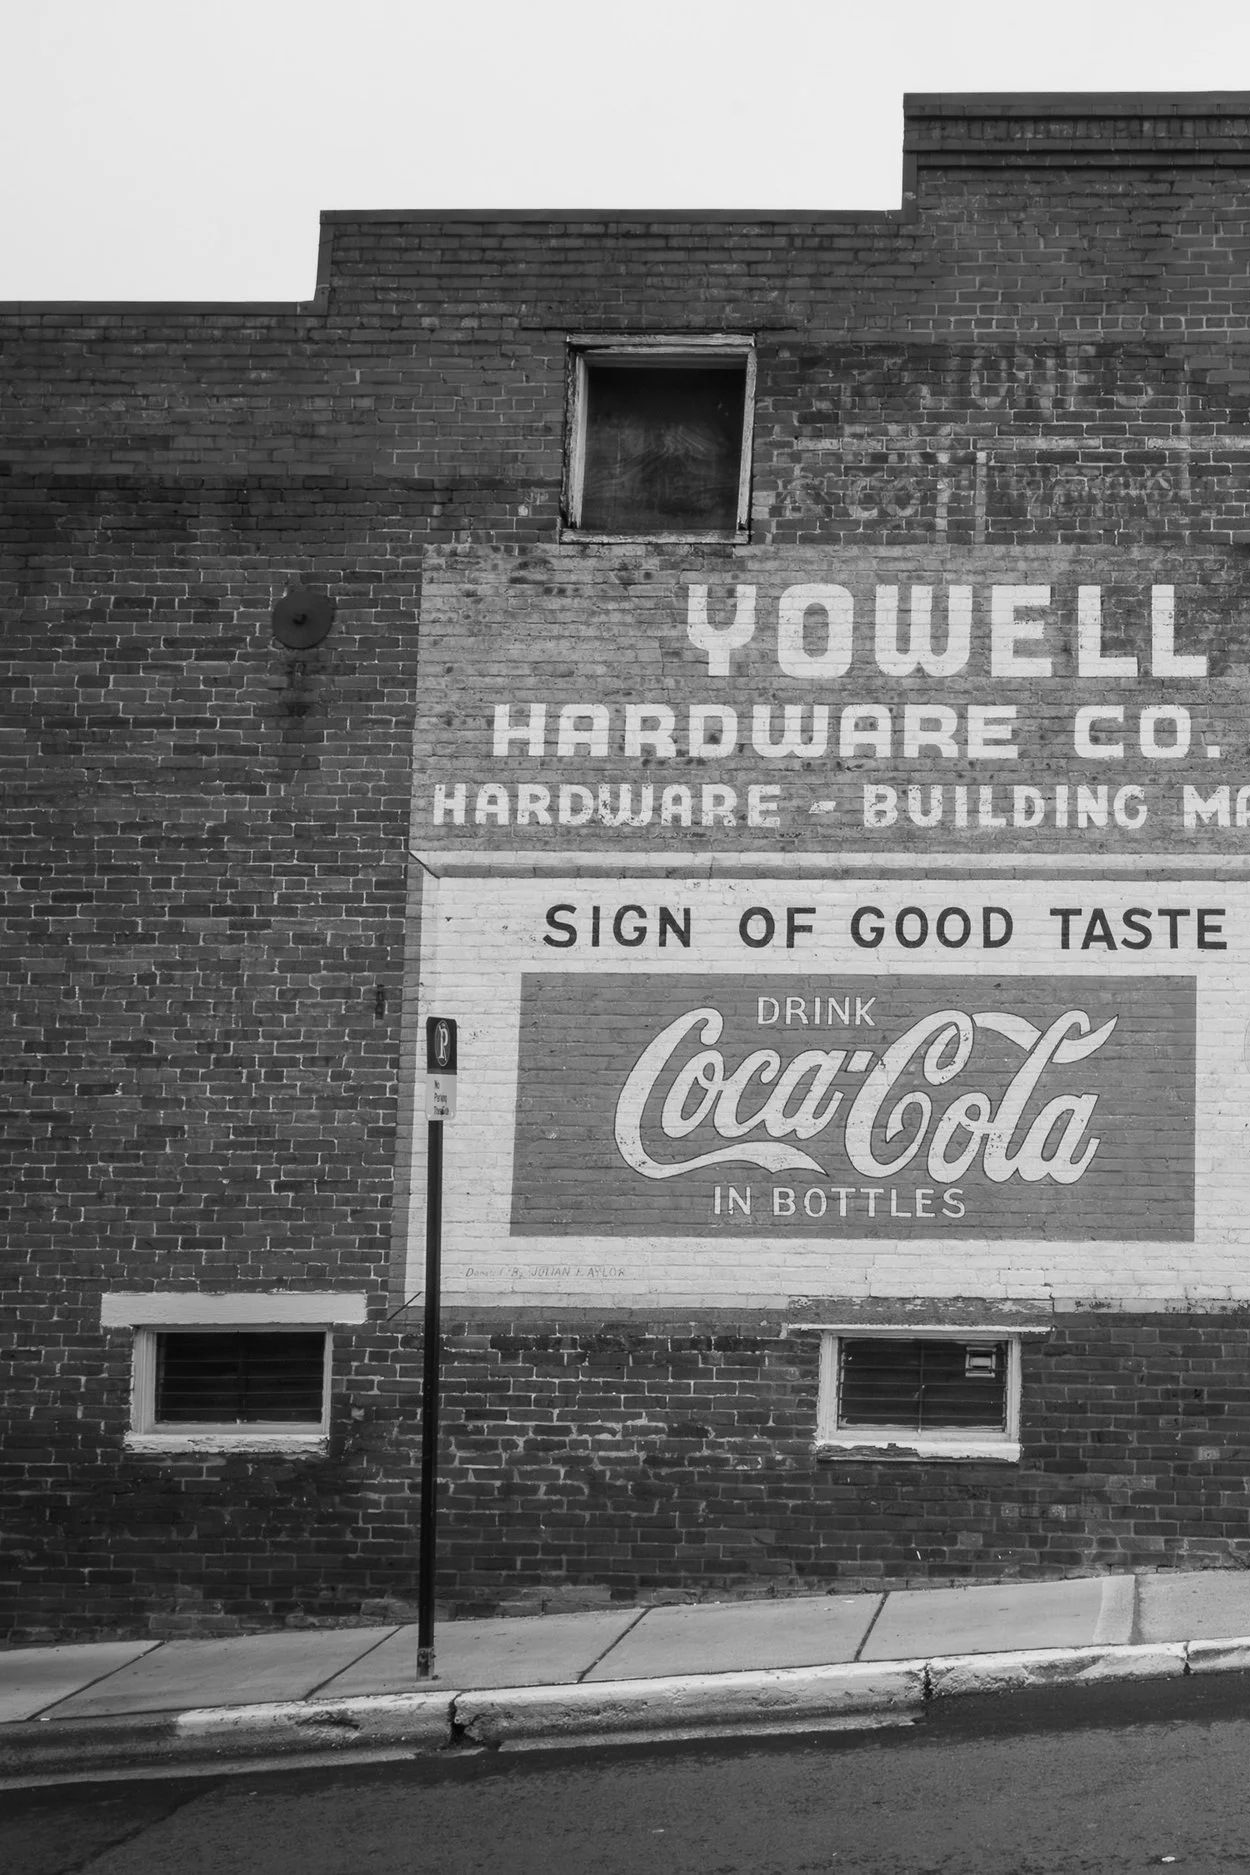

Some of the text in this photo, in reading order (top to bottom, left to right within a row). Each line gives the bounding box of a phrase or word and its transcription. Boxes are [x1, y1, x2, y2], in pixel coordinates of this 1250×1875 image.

[686, 582, 1208, 679] YOWELL
[491, 703, 1018, 759] HARDWARE
[432, 783, 781, 828] HARDWARE
[862, 784, 1148, 830] BUILDING
[542, 903, 1227, 952] SIGN OF GOOD TASTE
[757, 995, 878, 1028] DRINK
[613, 1007, 1120, 1186] Coca-Cola
[712, 1186, 967, 1220] IN BOTTLES
[530, 1266, 571, 1278] JULIAN
